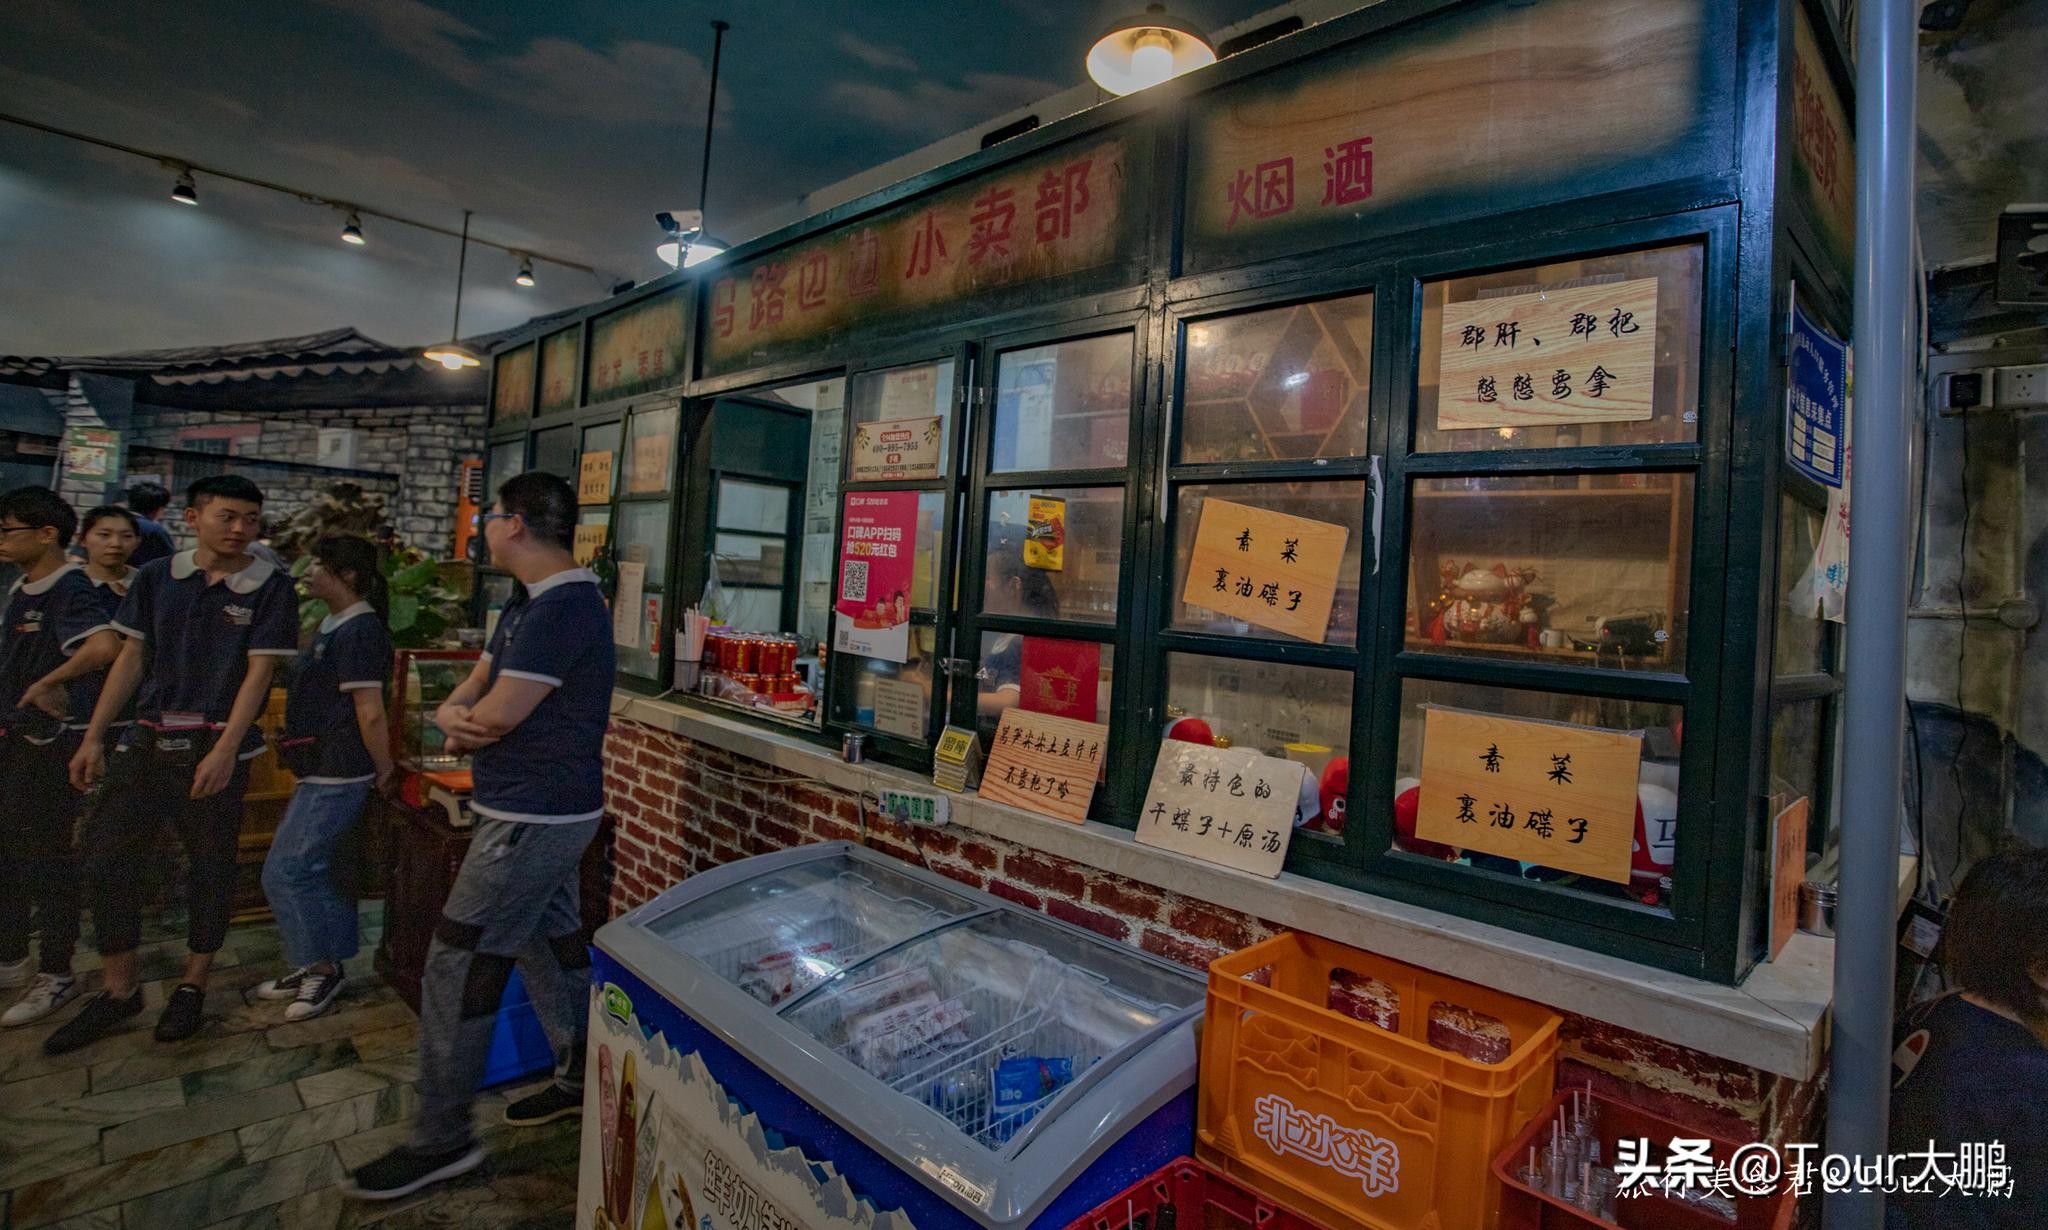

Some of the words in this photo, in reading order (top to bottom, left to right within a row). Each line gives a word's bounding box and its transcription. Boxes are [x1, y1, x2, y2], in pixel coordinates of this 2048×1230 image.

[1225, 136, 1373, 230] 烟酒
[712, 159, 1093, 338] 马路边边小卖部
[847, 526, 902, 541] 口碑APP扫码
[1235, 528, 1298, 564] 素菜
[1179, 764, 1271, 799] 最特色的
[1478, 744, 1573, 785] 素菜
[1254, 1094, 1400, 1198] 北冰洋
